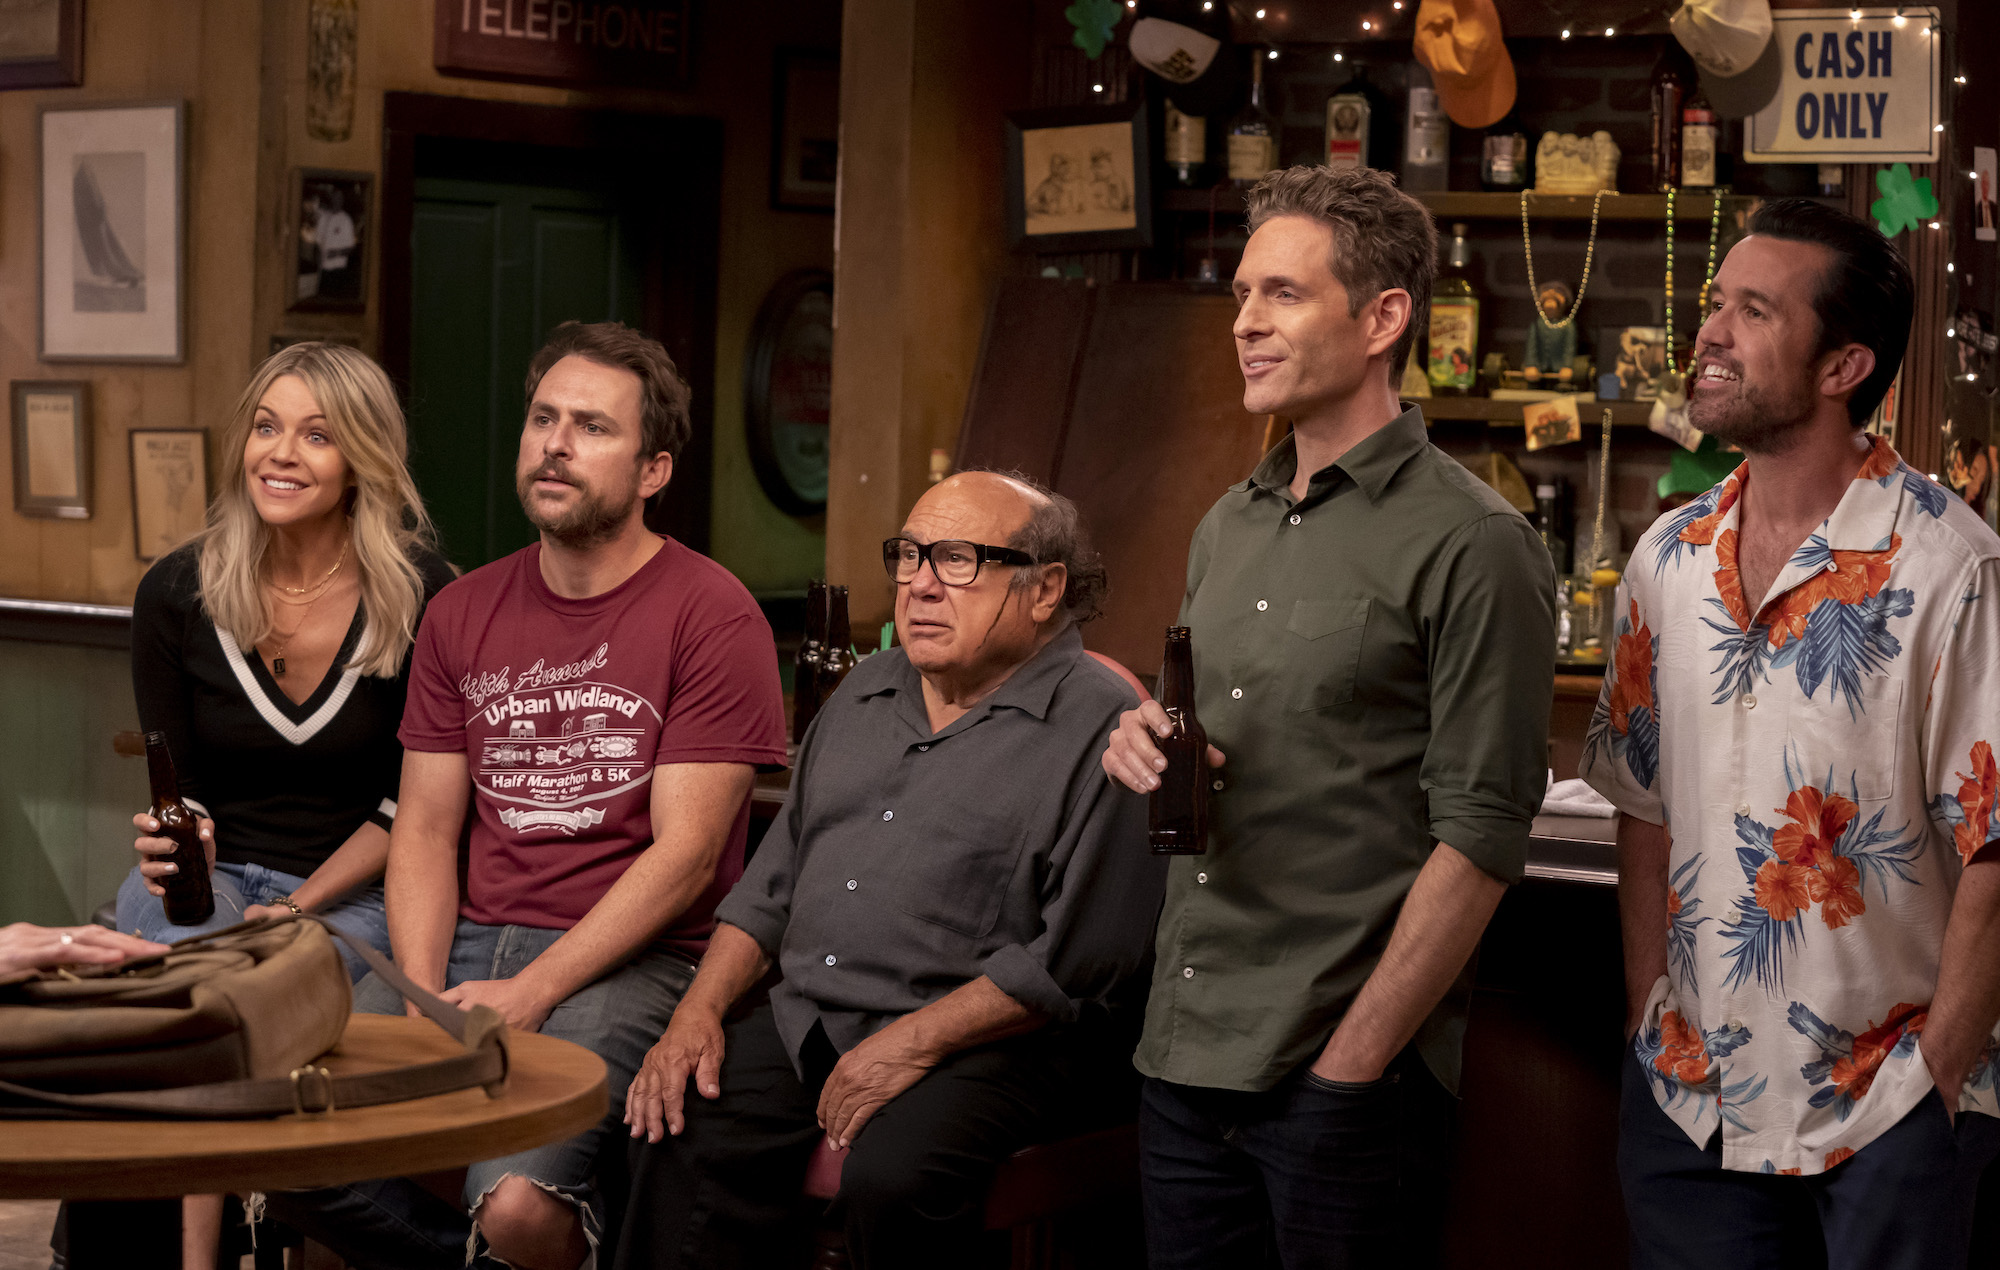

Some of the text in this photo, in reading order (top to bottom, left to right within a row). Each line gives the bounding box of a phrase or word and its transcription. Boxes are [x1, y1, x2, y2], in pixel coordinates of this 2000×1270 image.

[1794, 31, 1892, 79] CASH
[1796, 92, 1889, 140] ONLY
[484, 687, 643, 727] Urban Wdland
[491, 768, 632, 789] Half Marathon & 5K
[529, 787, 560, 796] August
